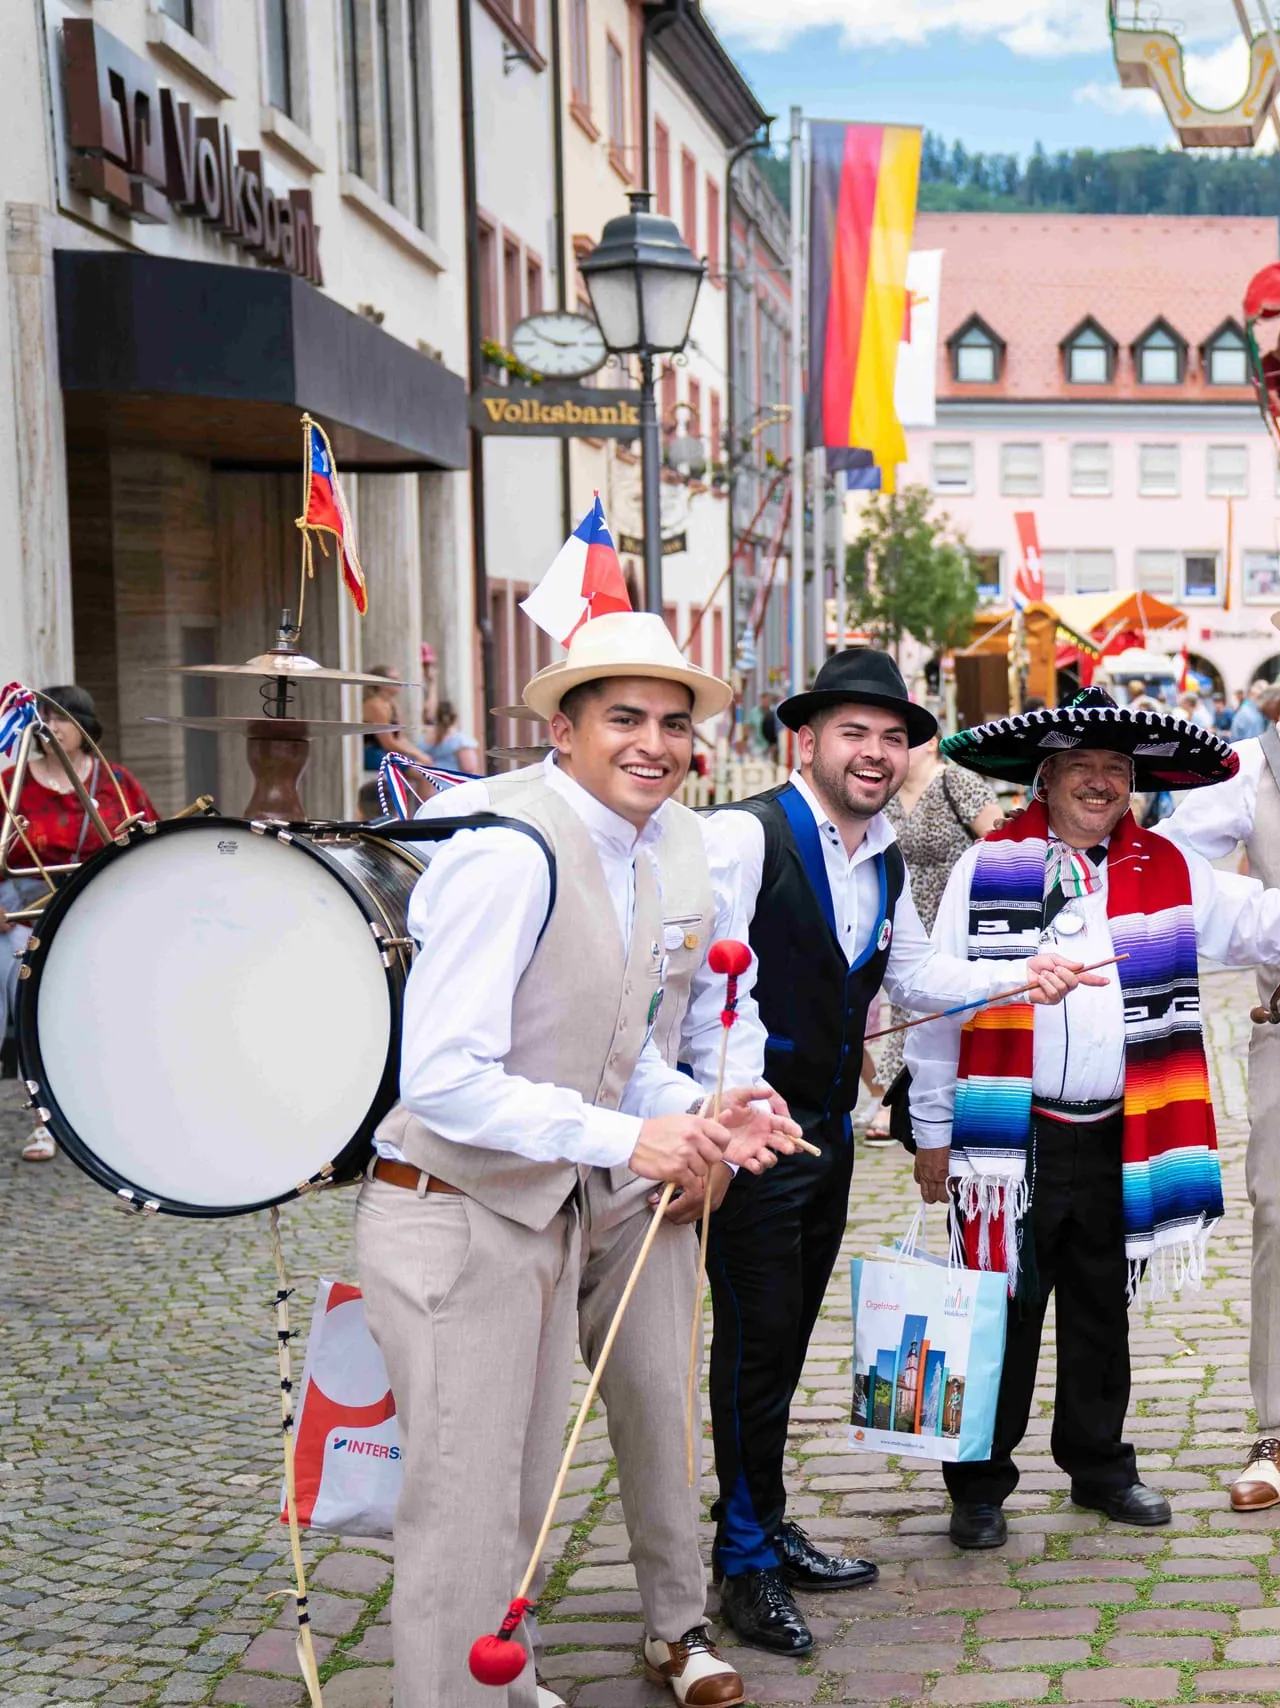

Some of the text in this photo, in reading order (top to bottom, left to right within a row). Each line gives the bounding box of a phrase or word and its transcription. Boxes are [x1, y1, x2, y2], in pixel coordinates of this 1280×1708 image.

[158, 88, 324, 287] Volksbank
[483, 398, 640, 426] Volksbank
[347, 1439, 402, 1460] INTERS
